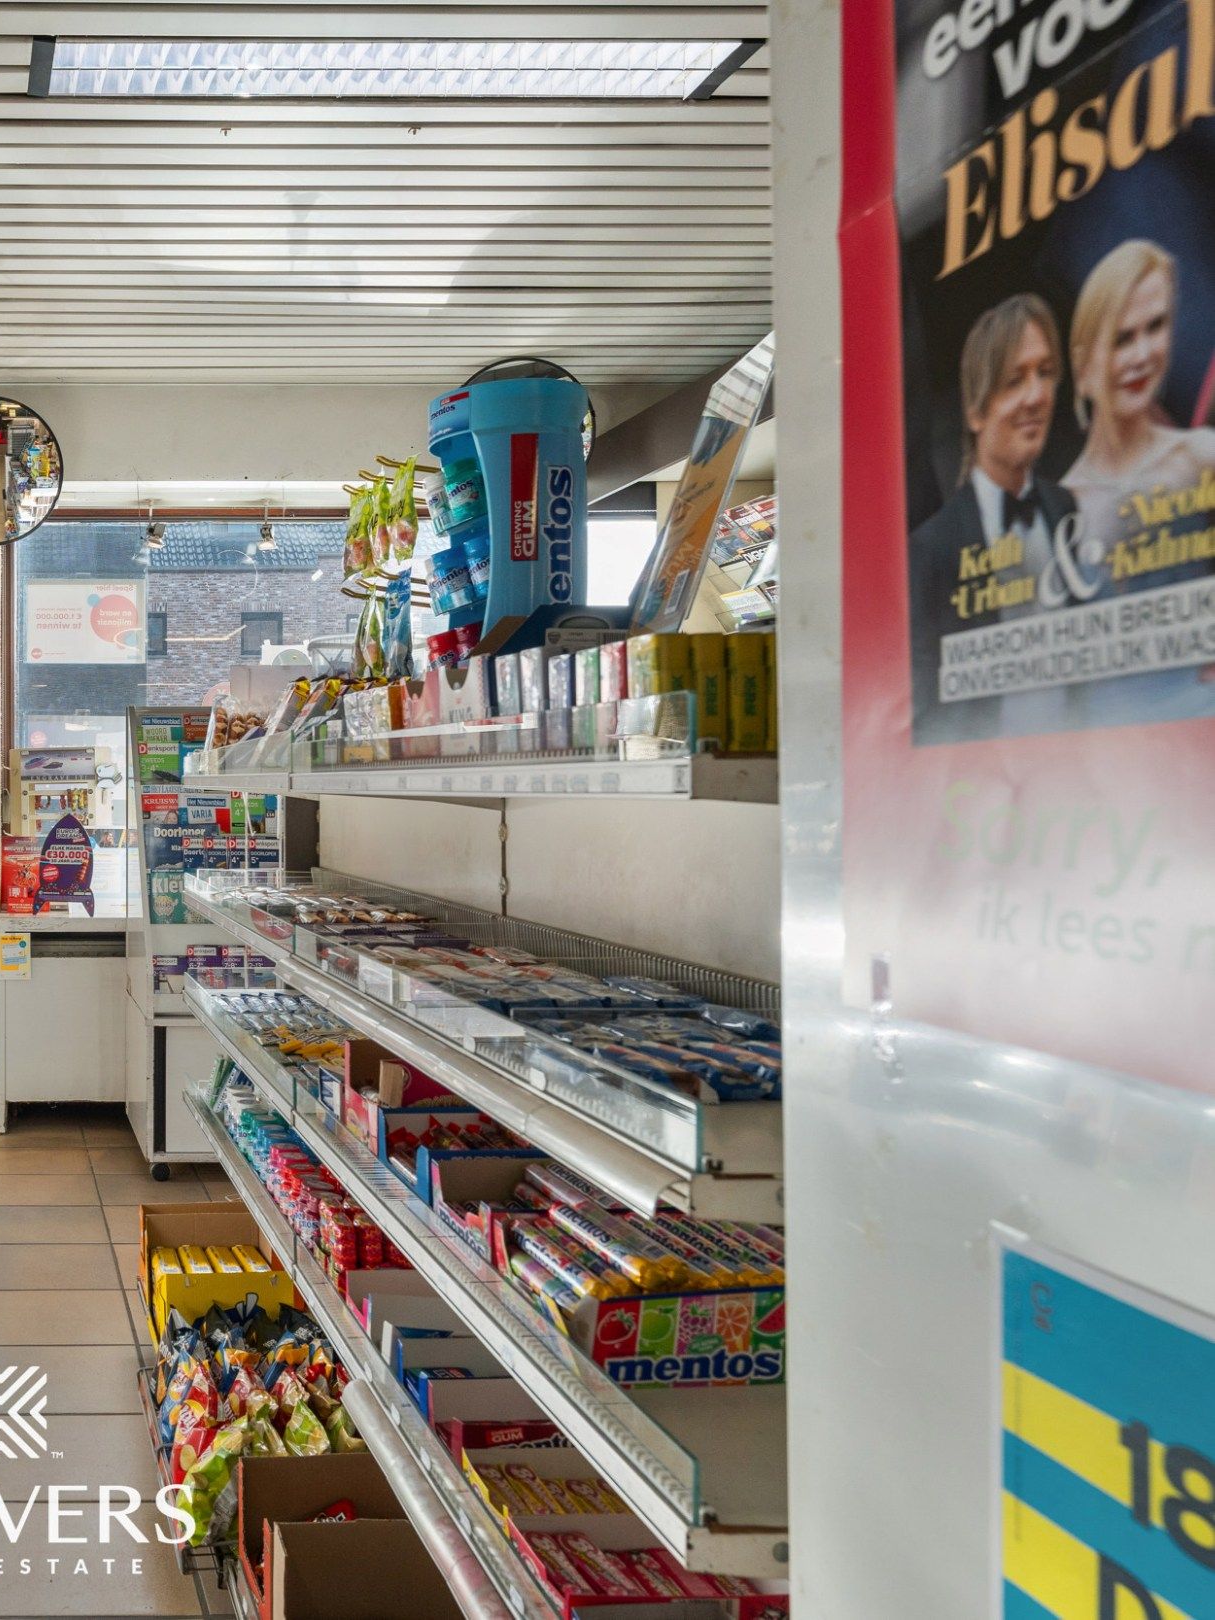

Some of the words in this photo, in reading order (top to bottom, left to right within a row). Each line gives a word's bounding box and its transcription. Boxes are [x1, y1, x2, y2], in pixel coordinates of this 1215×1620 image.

[514, 500, 522, 557] CHEWING
[522, 501, 535, 558] GUM
[543, 465, 573, 605] entos
[1054, 606, 1112, 646] HUN
[191, 809, 213, 819] VARIA
[46, 850, 89, 859] €30.000
[939, 779, 1172, 900] Sorry,
[1040, 888, 1158, 963] lees
[559, 1205, 611, 1245] mentos
[607, 1348, 781, 1383] mentos
[491, 1431, 524, 1443] GUM
